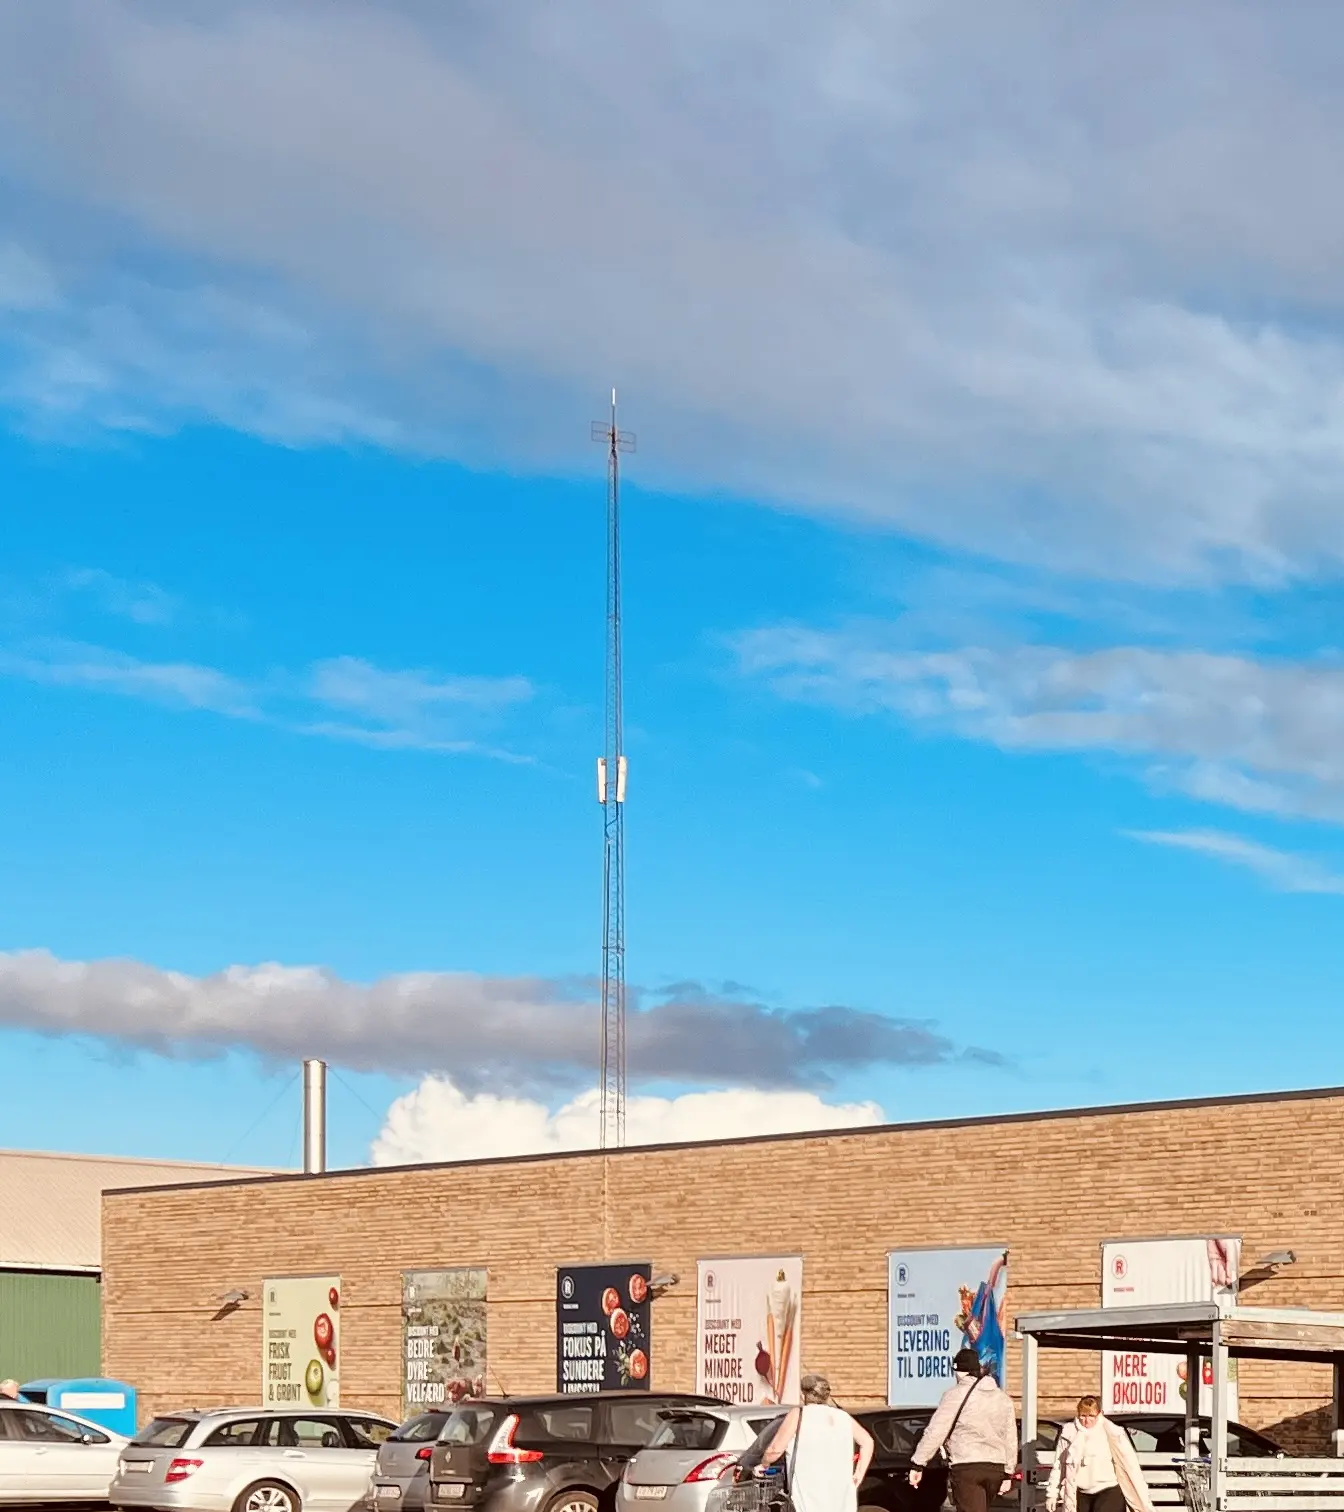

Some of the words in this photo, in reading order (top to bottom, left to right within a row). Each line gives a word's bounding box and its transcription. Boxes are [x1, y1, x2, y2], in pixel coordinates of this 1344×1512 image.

[897, 1314, 925, 1327] DISCOUNT
[268, 1342, 291, 1360] FRISK
[407, 1339, 435, 1359] BEDRE
[563, 1336, 593, 1358] FOKUS
[594, 1328, 608, 1358] PÅ
[704, 1333, 737, 1354] MEGET
[897, 1329, 950, 1353] LEVERING
[268, 1363, 293, 1381] FRUGT
[407, 1361, 433, 1381] DYRE-
[562, 1359, 606, 1381] SUNDERE
[704, 1358, 743, 1379] MINDRE
[897, 1356, 914, 1378] TIL
[1112, 1354, 1148, 1378] MERE
[268, 1384, 275, 1402] &
[276, 1383, 302, 1402] GRØNT
[406, 1382, 446, 1403] VELFÆRD
[704, 1381, 754, 1403] MADSPILD
[1112, 1381, 1167, 1405] ØKOLOGI
